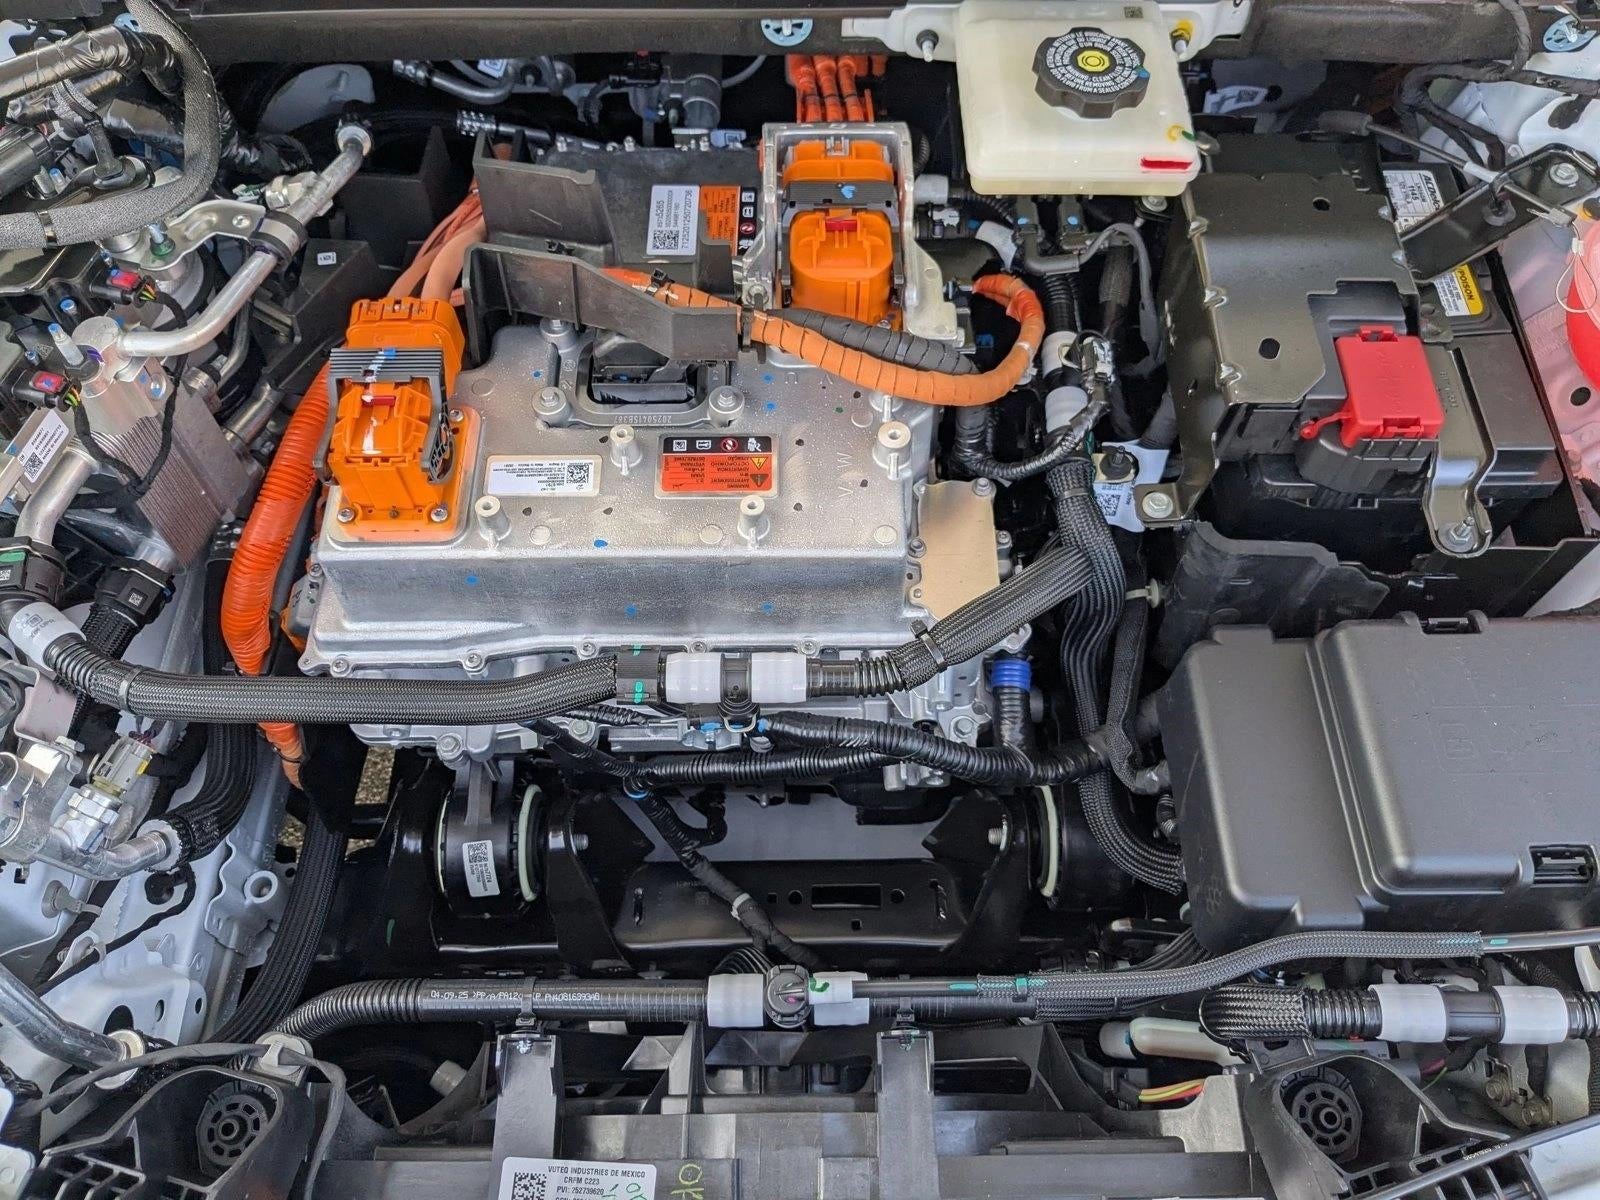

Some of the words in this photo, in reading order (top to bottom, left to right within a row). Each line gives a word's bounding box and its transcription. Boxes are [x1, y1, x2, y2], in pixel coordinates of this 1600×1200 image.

[1408, 185, 1419, 200] 1145
[1458, 270, 1475, 300] POISON
[548, 1166, 568, 1174] VUTEQ
[570, 1167, 608, 1176] INDUSTRIES
